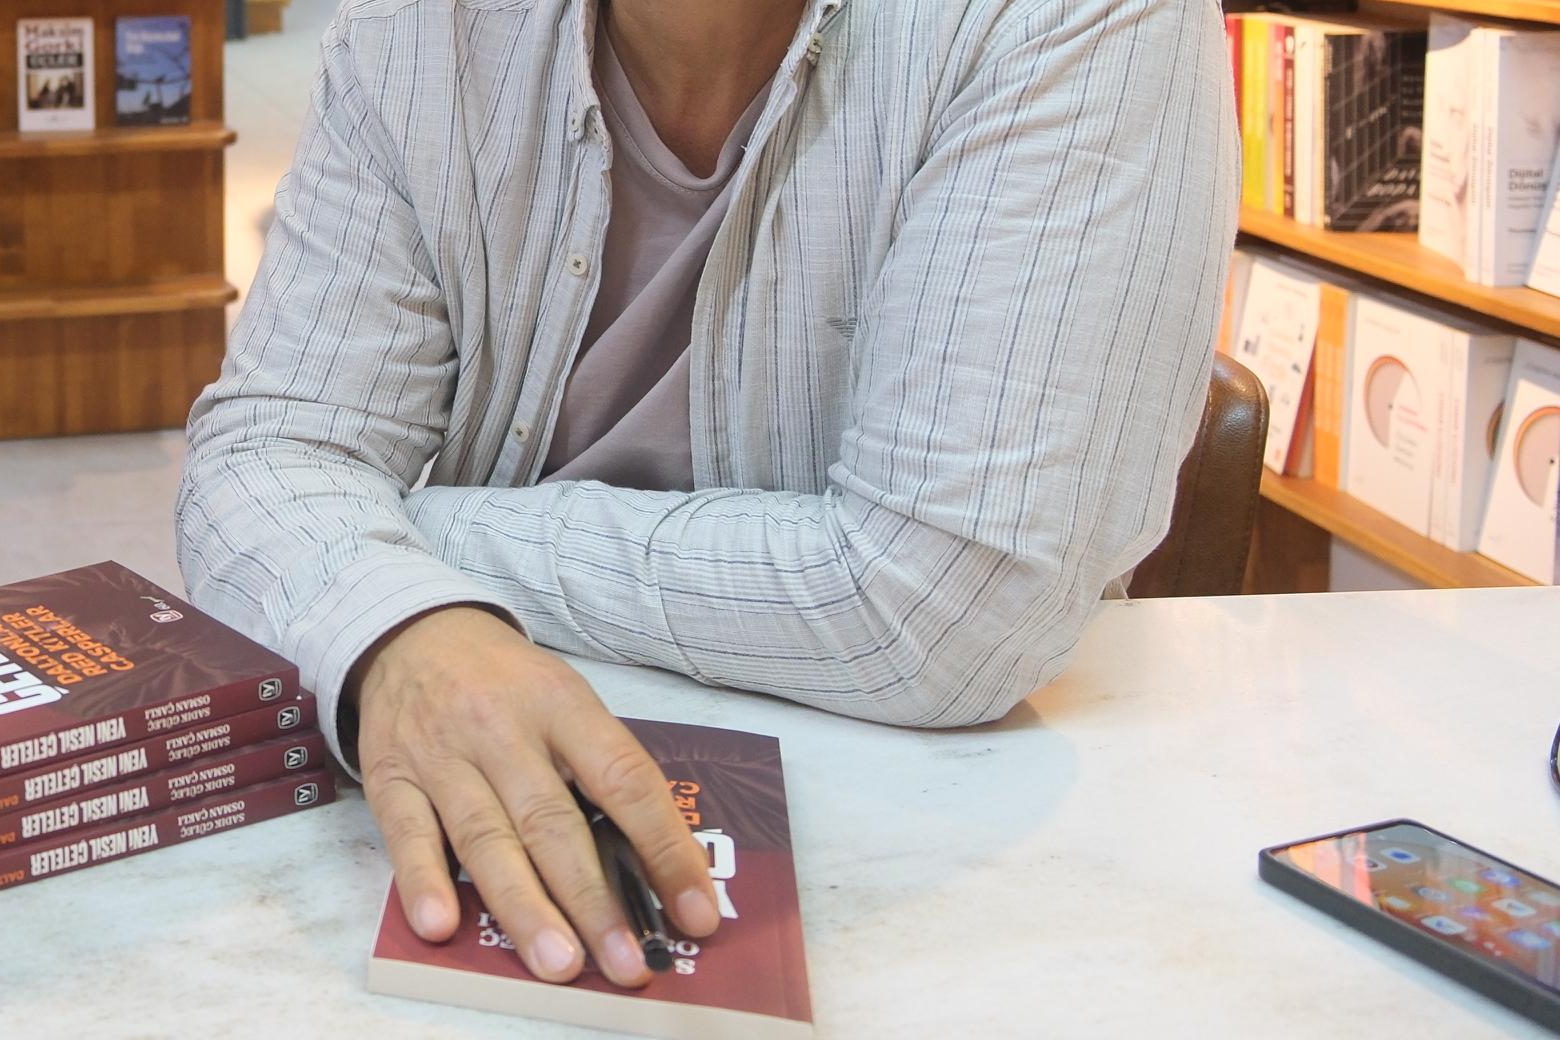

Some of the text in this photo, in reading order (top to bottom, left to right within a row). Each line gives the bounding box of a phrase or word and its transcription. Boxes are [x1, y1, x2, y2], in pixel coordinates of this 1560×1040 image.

[1, 611, 108, 677] RED KİTLER
[26, 605, 136, 671] CASPERLAR
[145, 695, 210, 719] OSMAN ÇAKLI
[147, 707, 210, 732] SADIK GÜLEÇ
[0, 717, 127, 769] YENİ NESİL ÇETELER
[166, 724, 231, 750] OSMAN ÇAKLI
[168, 736, 231, 762] SADIK GÜLEÇ
[24, 748, 148, 801] YENİ NESİL ÇETELER
[168, 764, 235, 789] OSMAN ÇAKLI
[170, 776, 235, 801] SADIK GÜLEÇ
[22, 786, 149, 838] YENİ NESİL ÇETELER
[178, 801, 245, 826] OSMAN ÇAKLI
[180, 813, 245, 838] SADIK GÜLEÇ
[30, 824, 158, 876] YENİ NESİL ÇETELER
